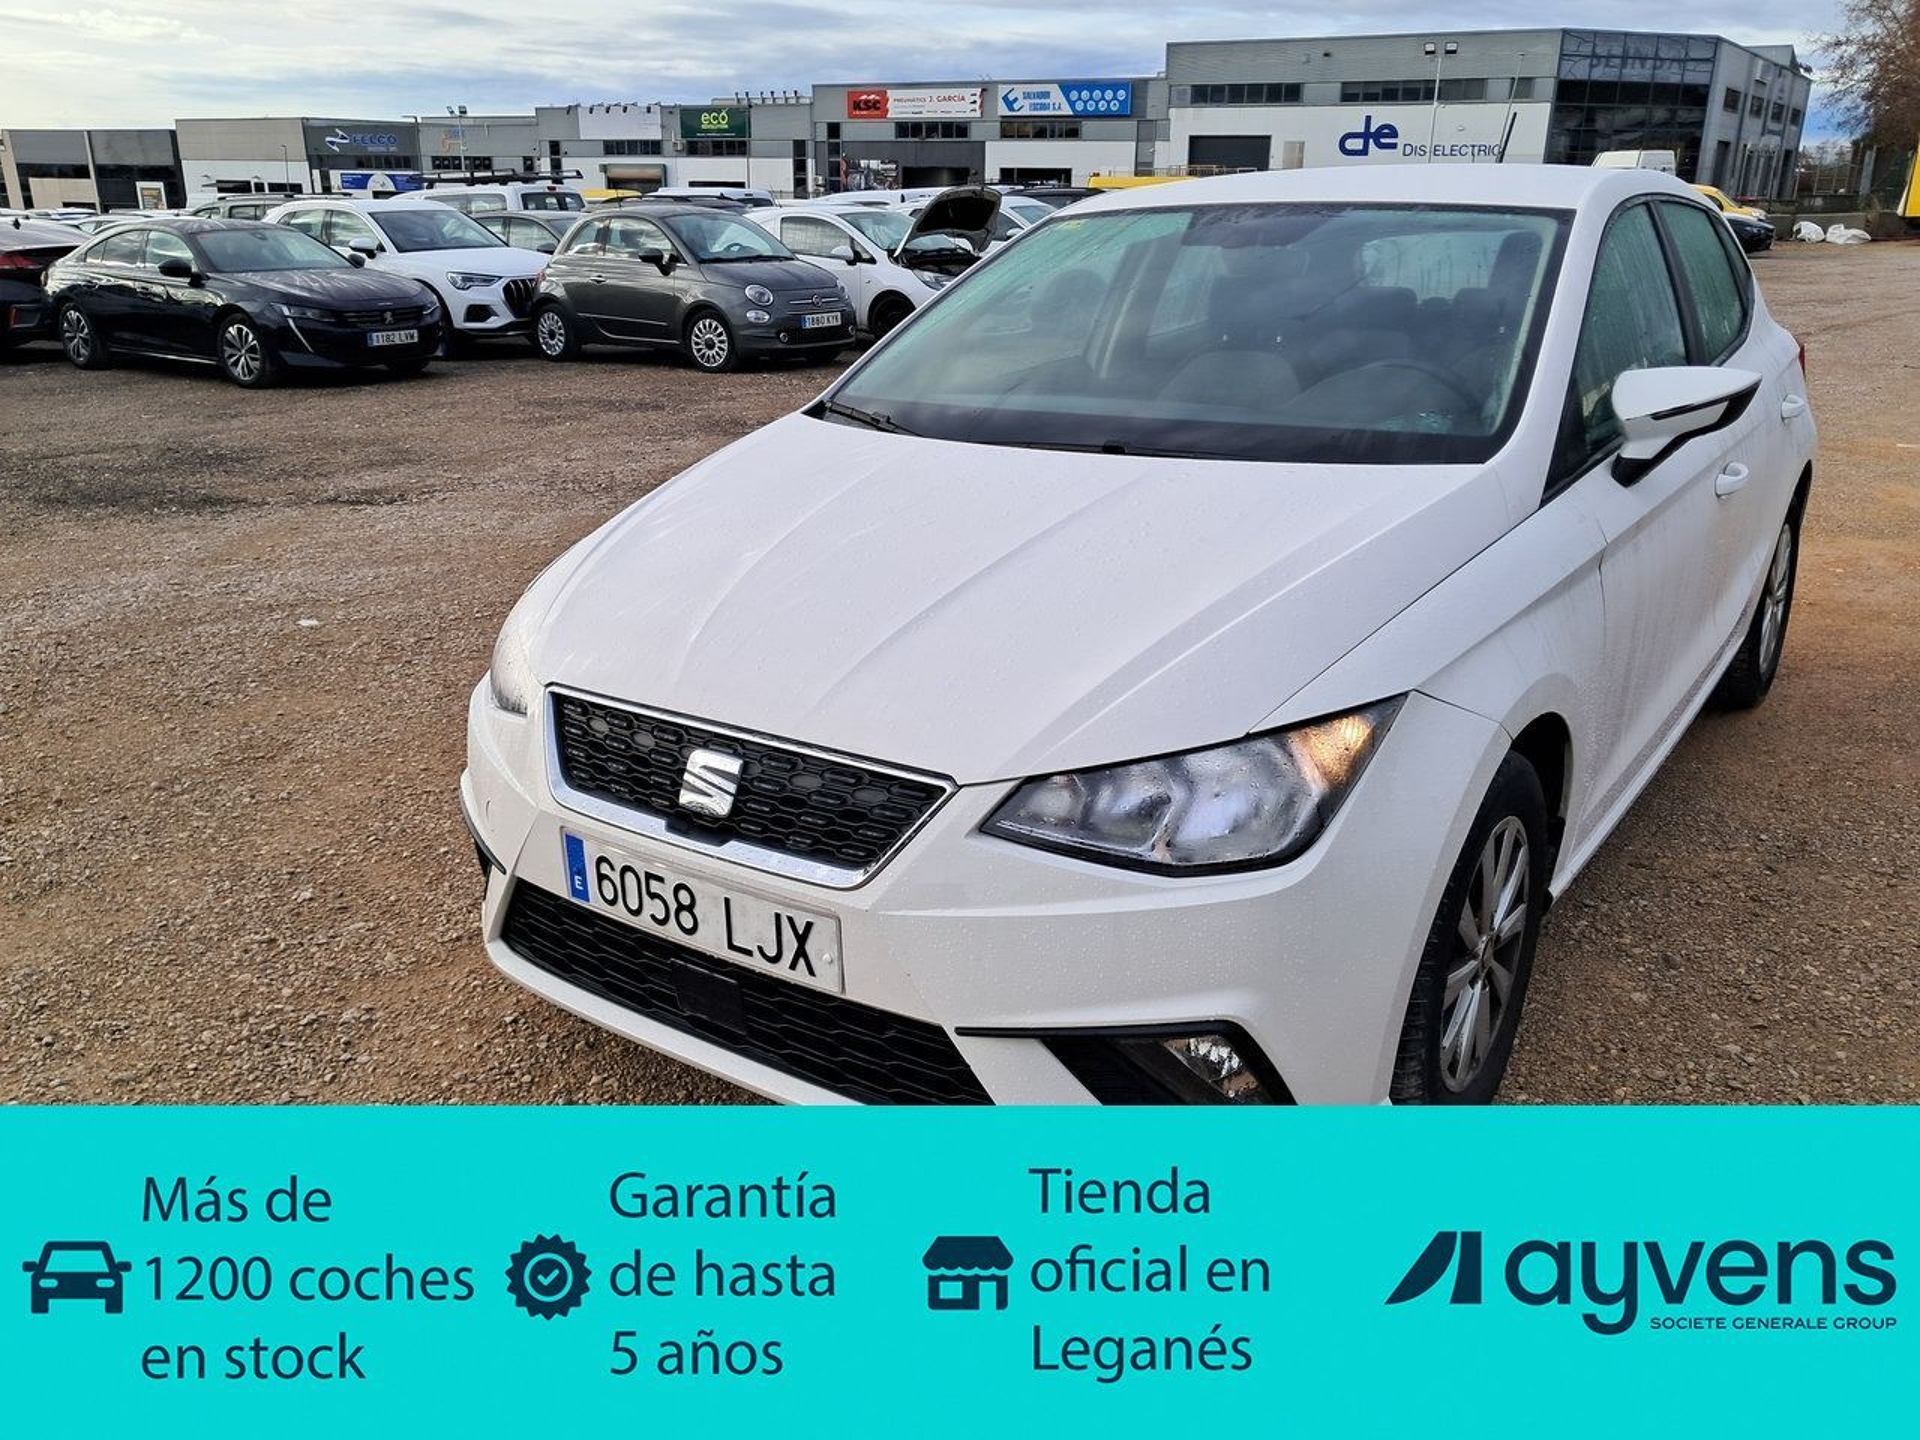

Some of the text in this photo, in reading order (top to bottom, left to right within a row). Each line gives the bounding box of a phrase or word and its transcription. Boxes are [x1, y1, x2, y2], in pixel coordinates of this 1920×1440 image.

[937, 93, 967, 103] GARCÍA
[853, 99, 881, 111] KSC
[1338, 115, 1399, 156] de
[375, 333, 396, 344] 1182
[574, 876, 584, 891] E
[594, 855, 817, 978] 6058 LJX
